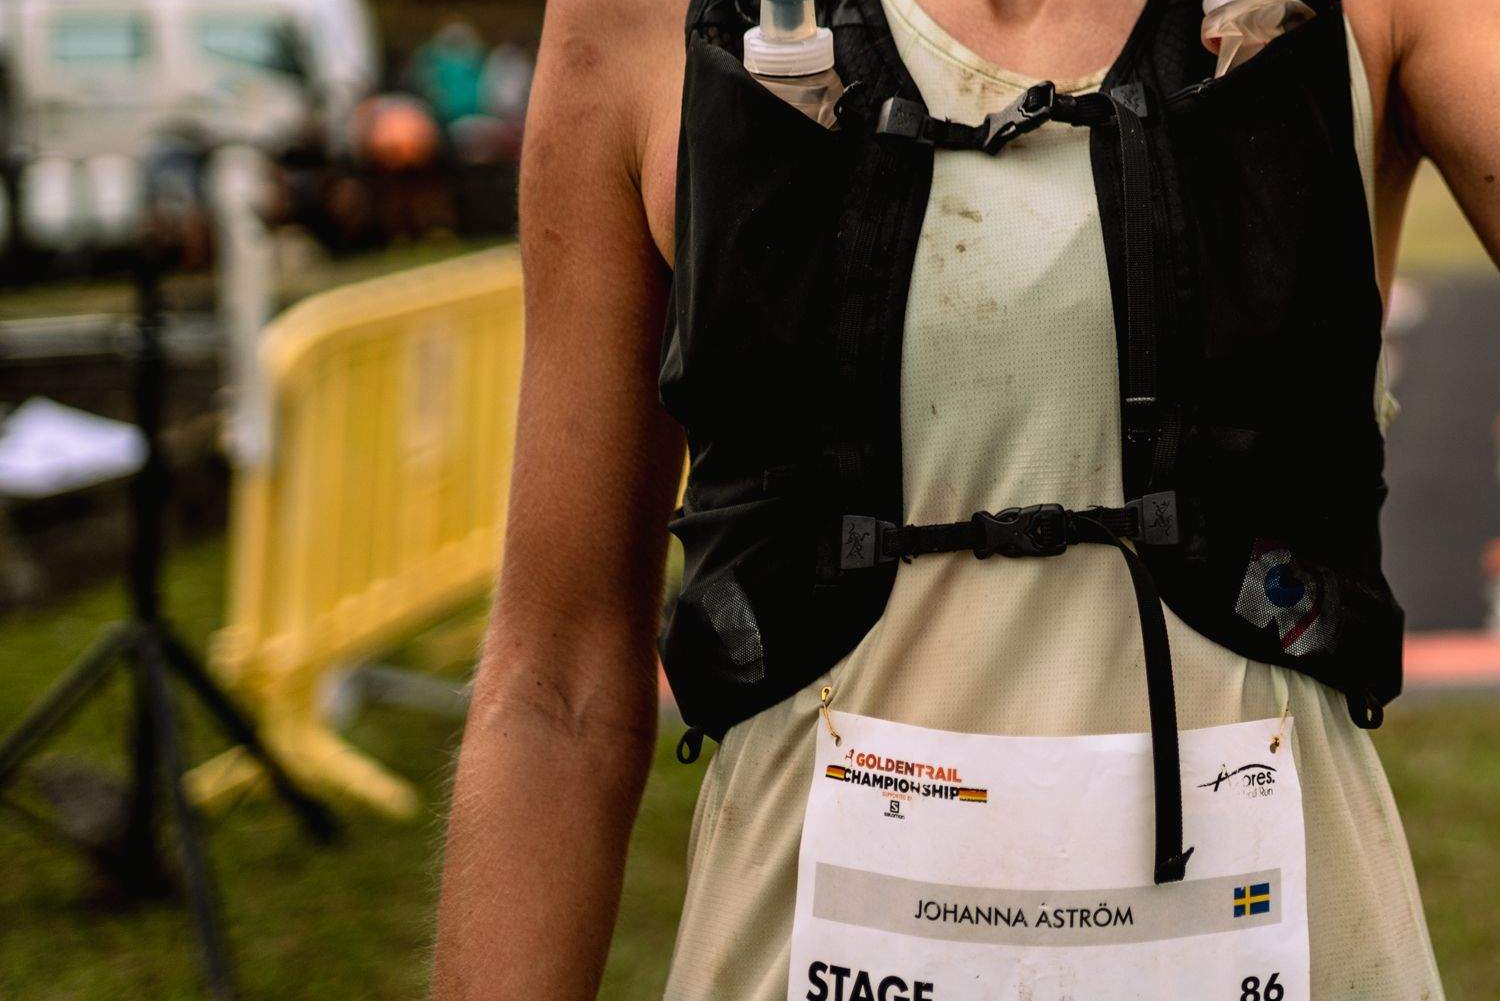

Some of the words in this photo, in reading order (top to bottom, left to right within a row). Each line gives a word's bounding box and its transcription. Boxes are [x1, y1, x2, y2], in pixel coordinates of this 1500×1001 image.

[843, 766, 960, 800] CHAMPIONSHIP
[856, 752, 962, 783] GOLDENTRAIL
[914, 900, 1028, 928] JOHANNA
[806, 960, 934, 1001] STAGE
[1240, 972, 1285, 1001] 86
